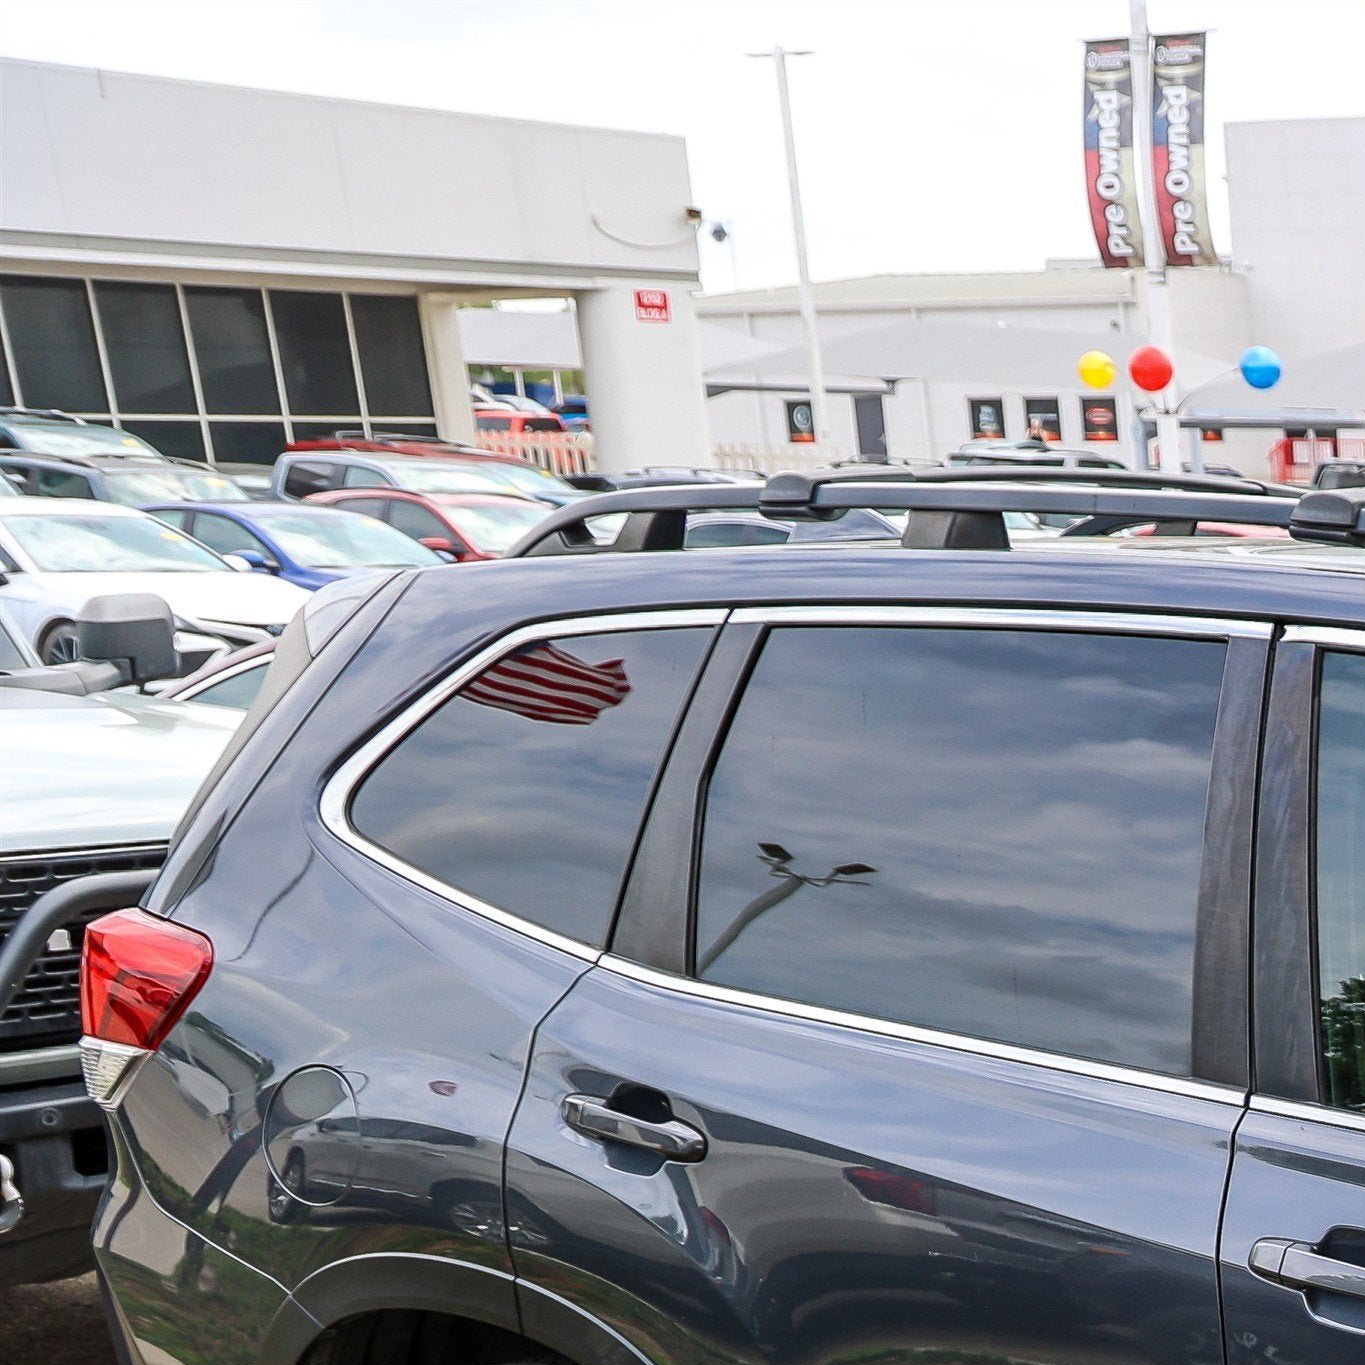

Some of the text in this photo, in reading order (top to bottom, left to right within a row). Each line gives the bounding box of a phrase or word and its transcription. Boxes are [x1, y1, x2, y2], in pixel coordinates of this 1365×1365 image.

[1094, 90, 1121, 201] Owned
[1162, 85, 1192, 198] Owned
[1105, 203, 1136, 257] Pre
[1172, 200, 1201, 256] Pre
